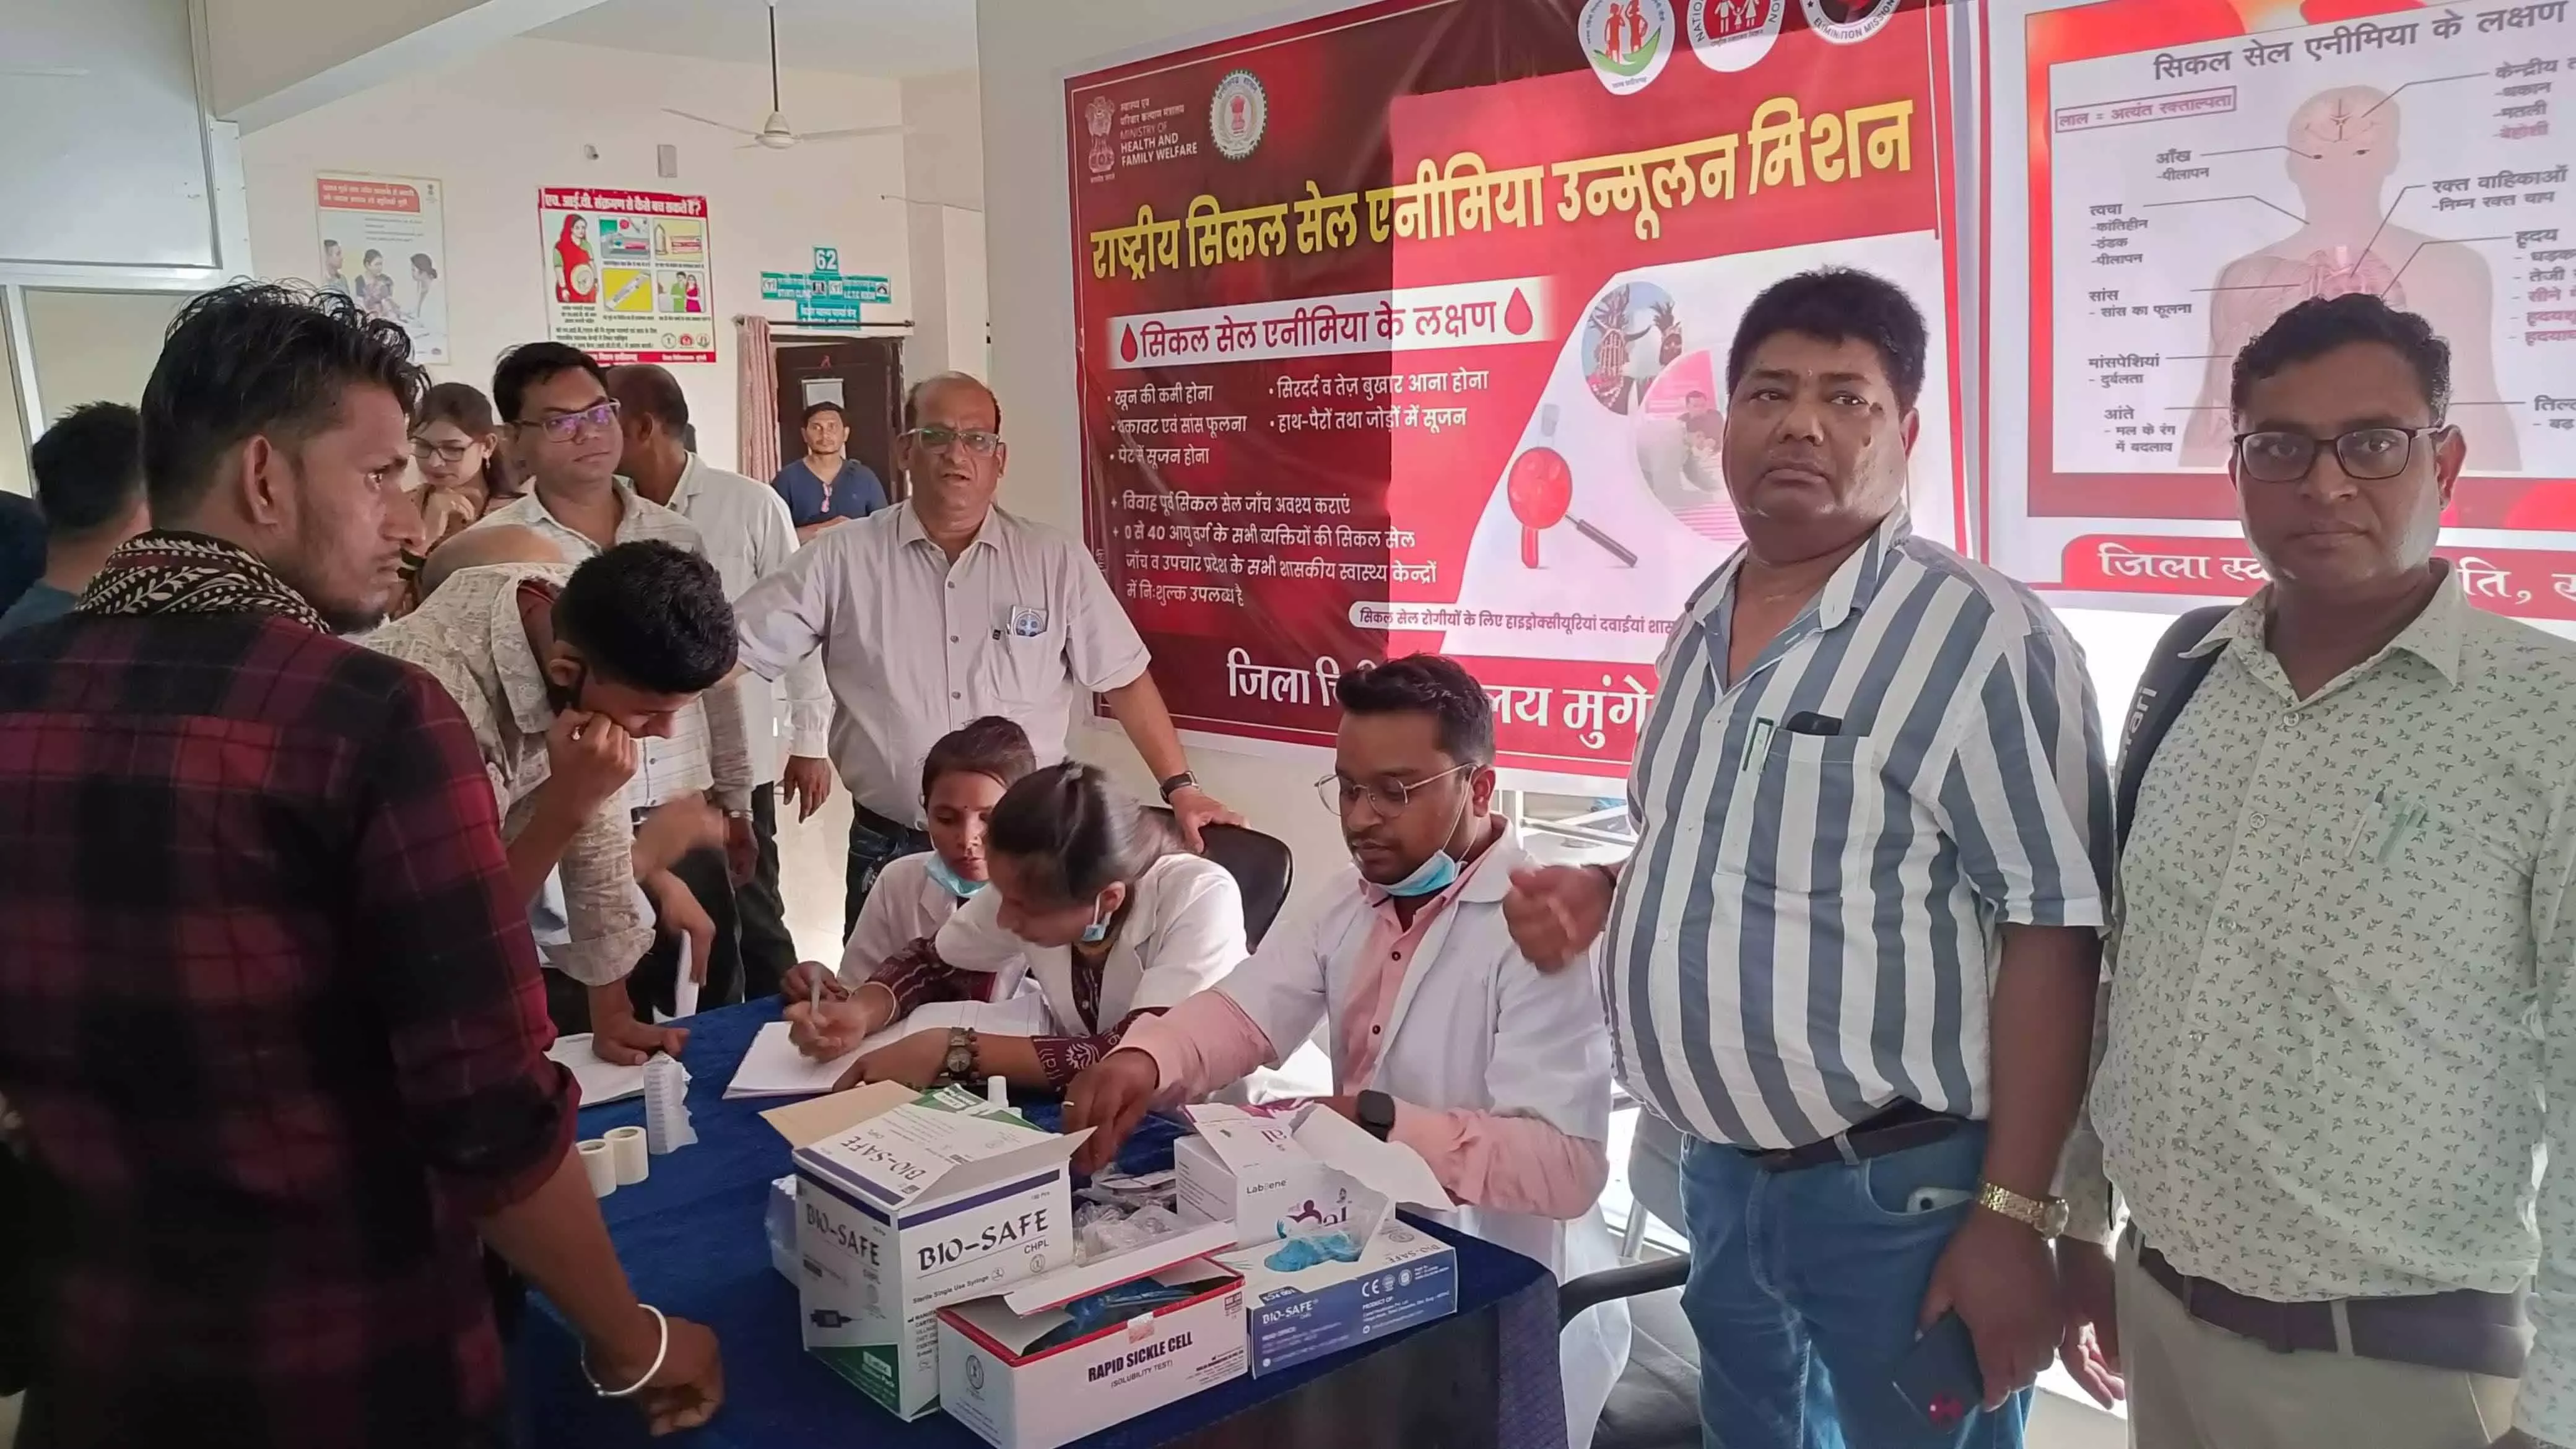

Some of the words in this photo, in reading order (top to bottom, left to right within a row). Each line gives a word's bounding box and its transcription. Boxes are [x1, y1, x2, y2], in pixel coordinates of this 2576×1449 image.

[1692, 1, 1705, 42] NATIO
[2153, 50, 2232, 80] सिकल
[2242, 38, 2294, 67] सेल
[2304, 22, 2419, 61] एनीमिया
[2432, 9, 2464, 39] के
[2477, 0, 2569, 32] लक्षण
[2059, 111, 2089, 127] लाल
[2111, 102, 2153, 120] अत्यंत
[1120, 124, 1155, 139] MINISTRY
[1157, 121, 1167, 133] OF
[1121, 137, 1155, 154] HEALTH
[1158, 133, 1178, 147] AND
[1121, 150, 1154, 168] FAMILY
[1155, 142, 1198, 161] WELFARE
[1090, 204, 1180, 281] राष्ट्रीय
[1186, 194, 1288, 267] सिकल
[1295, 181, 1359, 255] सेल
[1365, 152, 1544, 243] एनीमिया
[1551, 133, 1739, 240] उन्मूलन
[1747, 97, 1914, 195] मिशन
[2432, 178, 2471, 193] रक्त
[2089, 203, 2123, 216] त्वचा
[2482, 194, 2516, 207] रक्त
[2515, 228, 2559, 249] हृदय
[816, 249, 838, 271] 62
[2089, 287, 2120, 302] सांस
[2100, 305, 2126, 317] सांस
[2132, 305, 2148, 316] का
[2153, 303, 2192, 318] फूलना
[1140, 322, 1209, 359] सिकल
[1214, 315, 1256, 353] सेल
[1263, 298, 1367, 348] एनीमिया
[1375, 301, 1406, 340] के
[1412, 302, 1497, 337] लक्षण
[2088, 353, 2160, 369] मांसपेशियां
[1277, 376, 1320, 399] सिरदर्द
[1323, 379, 1333, 396] व
[1336, 372, 1359, 396] तेज़
[1362, 372, 1403, 401] बुखार
[1408, 371, 1448, 393] आना
[1451, 367, 1489, 392] होना
[2100, 373, 2144, 389] दुर्बलता
[1115, 388, 1138, 411] खून
[1140, 383, 1156, 405] की
[1159, 382, 1183, 404] कमी
[1185, 381, 1213, 402] होना
[1277, 406, 1333, 433] हाथ-पैरों
[1334, 411, 1362, 430] तथा
[1366, 406, 1401, 433] जोड़ों
[1404, 404, 1420, 427] में
[1422, 407, 1467, 434] सूजन
[2104, 405, 2135, 420] आंते
[1117, 417, 1159, 434] थकावट
[1161, 414, 1178, 435] एवं
[1180, 415, 1204, 434] सांस
[1206, 415, 1248, 438] फूलना
[2115, 425, 2136, 435] मल
[2142, 422, 2155, 435] के
[2160, 422, 2175, 435] रंग
[1118, 446, 1134, 465] पेट
[1135, 444, 1145, 463] में
[1146, 446, 1181, 470] सूजन
[1183, 443, 1209, 466] होना
[2115, 440, 2126, 453] में
[1123, 489, 1158, 511] विवाह
[1160, 491, 1175, 516] पूर्व
[1175, 490, 1217, 512] सिकल
[1221, 491, 1243, 513] सेल
[1245, 490, 1272, 514] जाँच
[1274, 495, 1311, 515] अवश्य
[1315, 493, 1351, 515] कराएं
[1124, 524, 1133, 541] 0
[1134, 520, 1146, 541] से
[1147, 525, 1166, 541] 40
[1213, 523, 1228, 542] के
[1232, 523, 1258, 545] सभी
[1260, 524, 1312, 547] व्यक्तियों
[1313, 524, 1333, 547] की
[1336, 524, 1382, 548] सिकल
[1385, 526, 1416, 550] सेल
[1125, 547, 1149, 571] जाँच
[1151, 553, 1160, 570] व
[1162, 554, 1203, 573] उपचार
[1204, 551, 1229, 574] प्रदेश
[1230, 553, 1243, 575] के
[1247, 555, 1277, 578] सभी
[1279, 556, 1336, 580] शासकीय
[1339, 564, 1389, 583] स्वास्थ्य
[1391, 559, 1438, 585] केन्द्रों
[2097, 542, 2213, 580] जिला
[1126, 579, 1138, 599] में
[1139, 580, 1187, 607] निःशुल्क
[1190, 586, 1234, 604] उपलब्ध
[1234, 582, 1245, 607] है
[1359, 606, 1394, 626] सिकल
[1396, 608, 1419, 627] सेल
[1421, 607, 1461, 628] रोगीयों
[1463, 611, 1477, 627] के
[1479, 611, 1503, 629] लिए
[1599, 613, 1645, 635] दवाईयां
[1225, 646, 1310, 705] जिला
[1563, 674, 1654, 750] मुंगे
[806, 1203, 880, 1266] BIO-SAFE
[917, 1208, 1049, 1271] BIO-SAFE
[1024, 1239, 1050, 1255] CHPL
[933, 1285, 954, 1298] Single
[954, 1281, 967, 1291] Use
[967, 1275, 990, 1287] Syringe
[1262, 1300, 1314, 1325] BIO-SAFE
[1088, 1357, 1124, 1382] RAPID
[1126, 1340, 1166, 1367] SICKLE
[1168, 1331, 1193, 1353] CELL
[1111, 1367, 1153, 1388] (SOLUBILITY
